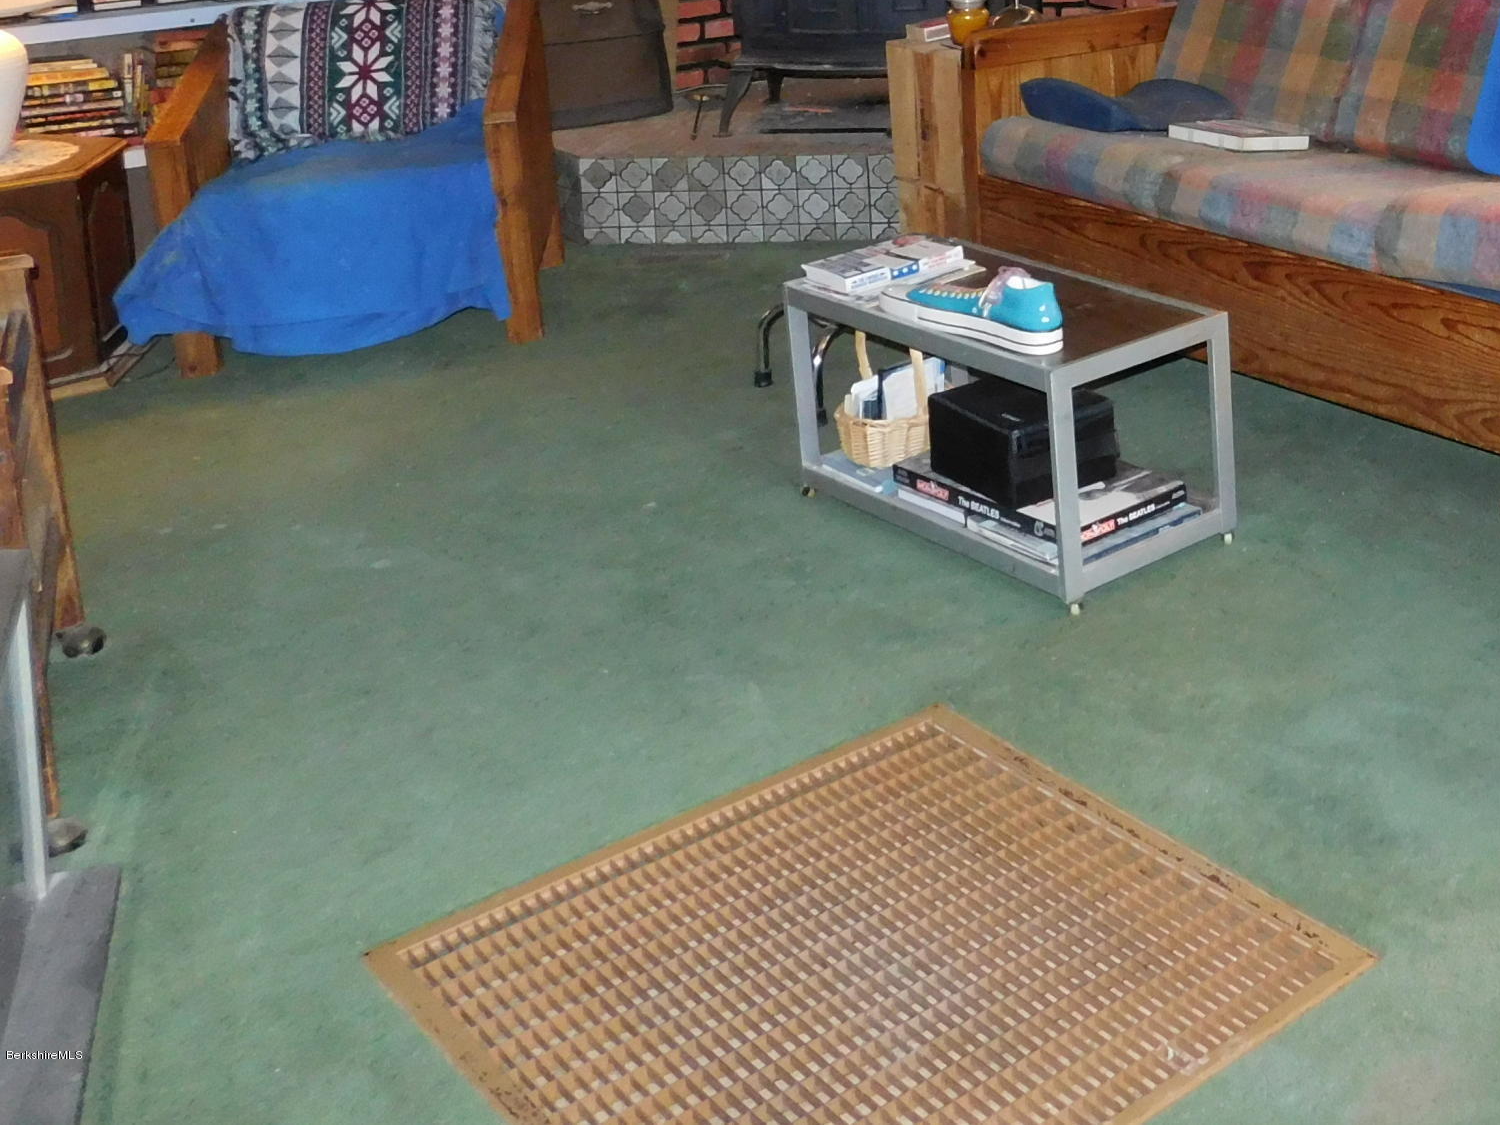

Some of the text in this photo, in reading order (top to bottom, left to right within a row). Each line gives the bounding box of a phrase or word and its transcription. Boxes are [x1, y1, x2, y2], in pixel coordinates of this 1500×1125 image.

[957, 496, 1000, 519] The BEATLES
[1129, 503, 1156, 521] BEATLES
